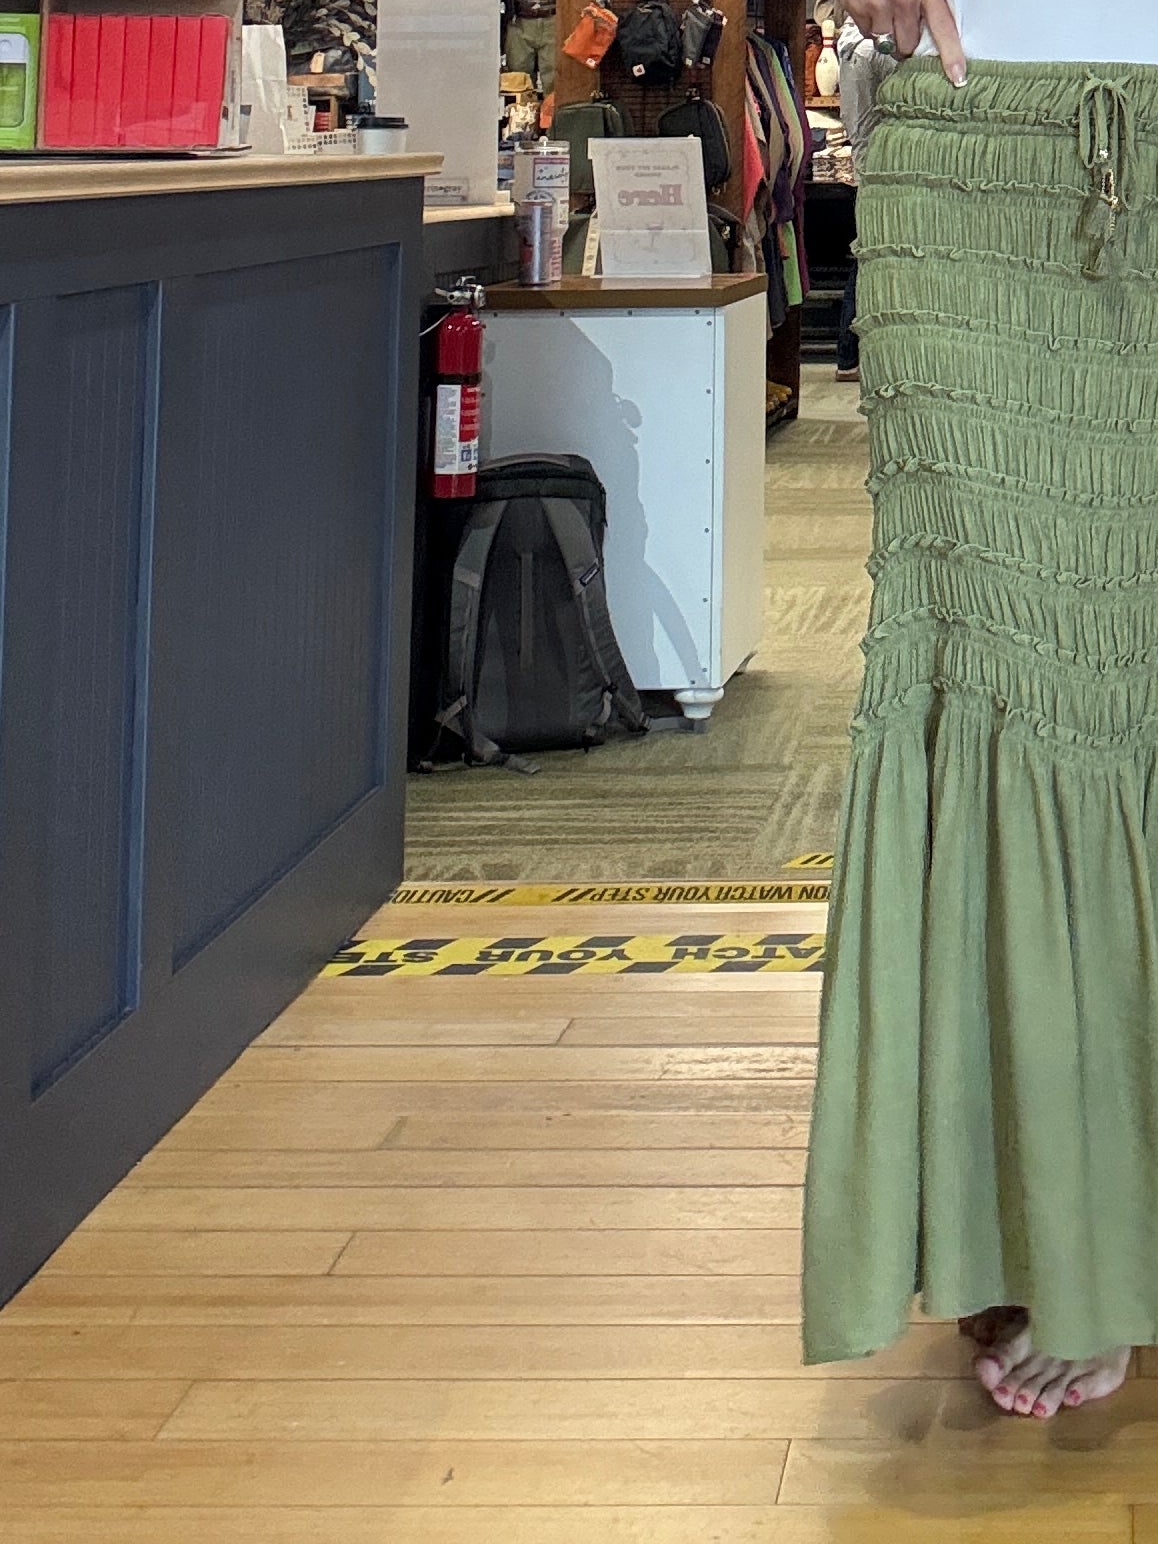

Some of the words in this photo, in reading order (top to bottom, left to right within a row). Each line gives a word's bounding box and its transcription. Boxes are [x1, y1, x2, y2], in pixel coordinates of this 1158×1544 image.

[390, 888, 475, 904] CAUTIO
[590, 887, 650, 902] STEP
[652, 886, 713, 902] YOUR
[715, 885, 793, 900] WATCH
[328, 951, 438, 964] STE
[475, 947, 634, 963] YOUR
[671, 946, 826, 960] ATCH
